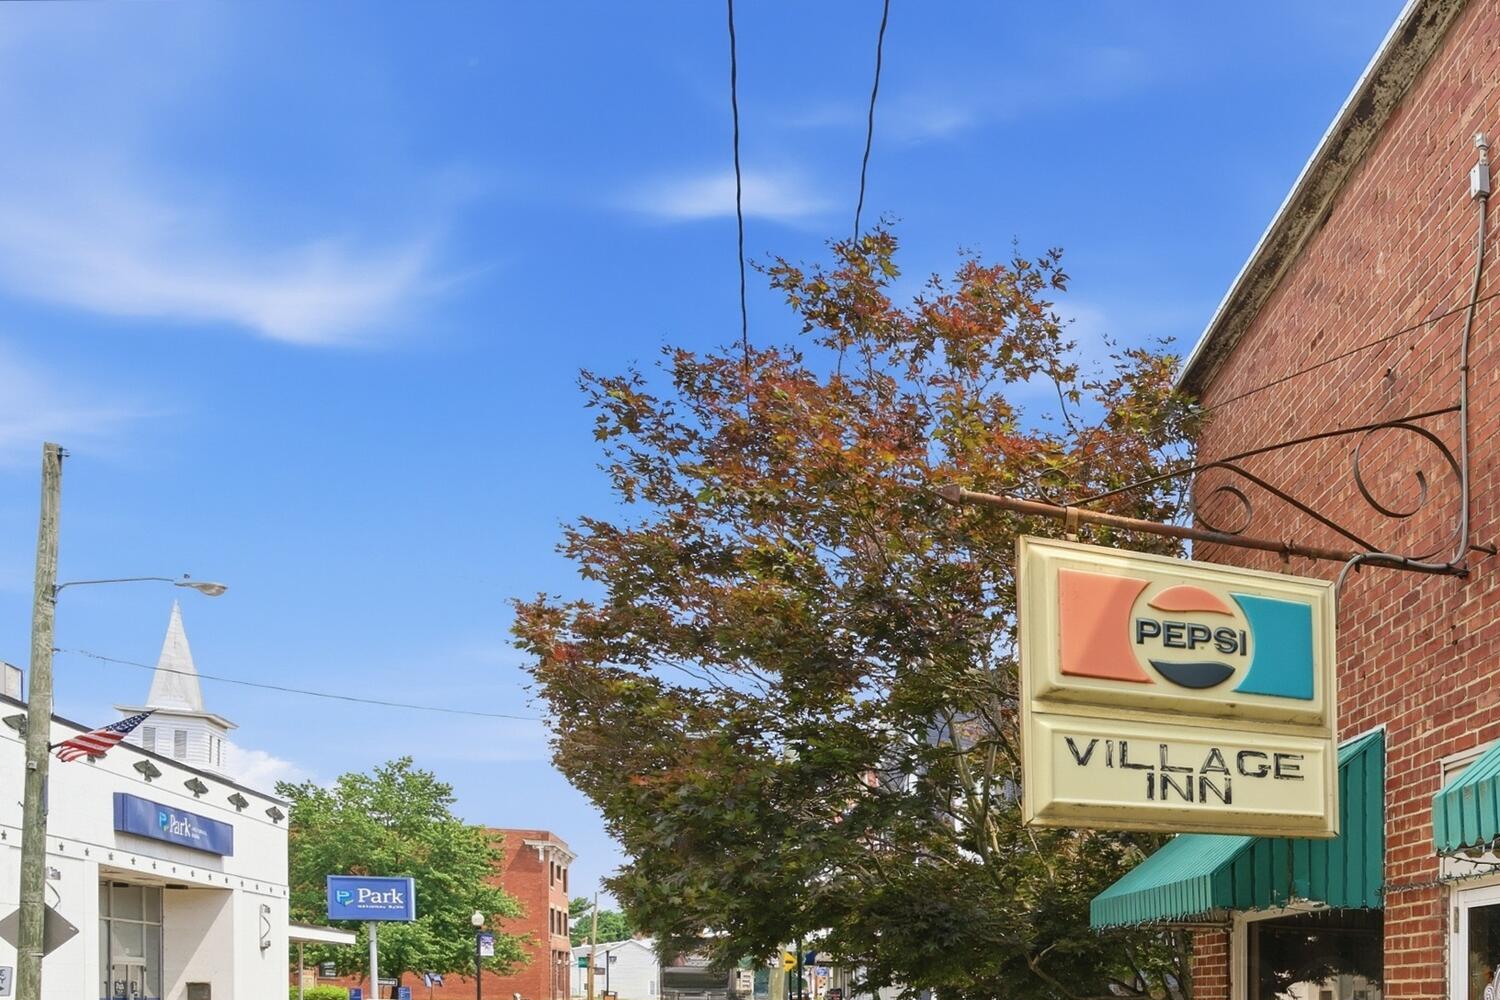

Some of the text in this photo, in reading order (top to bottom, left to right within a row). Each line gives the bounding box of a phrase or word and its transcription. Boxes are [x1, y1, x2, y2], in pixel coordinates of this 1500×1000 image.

[1135, 617, 1248, 656] PEPSI
[1064, 736, 1304, 781] VILLAGE
[1147, 772, 1232, 804] INN
[169, 814, 192, 837] Park
[357, 888, 404, 904] Park
